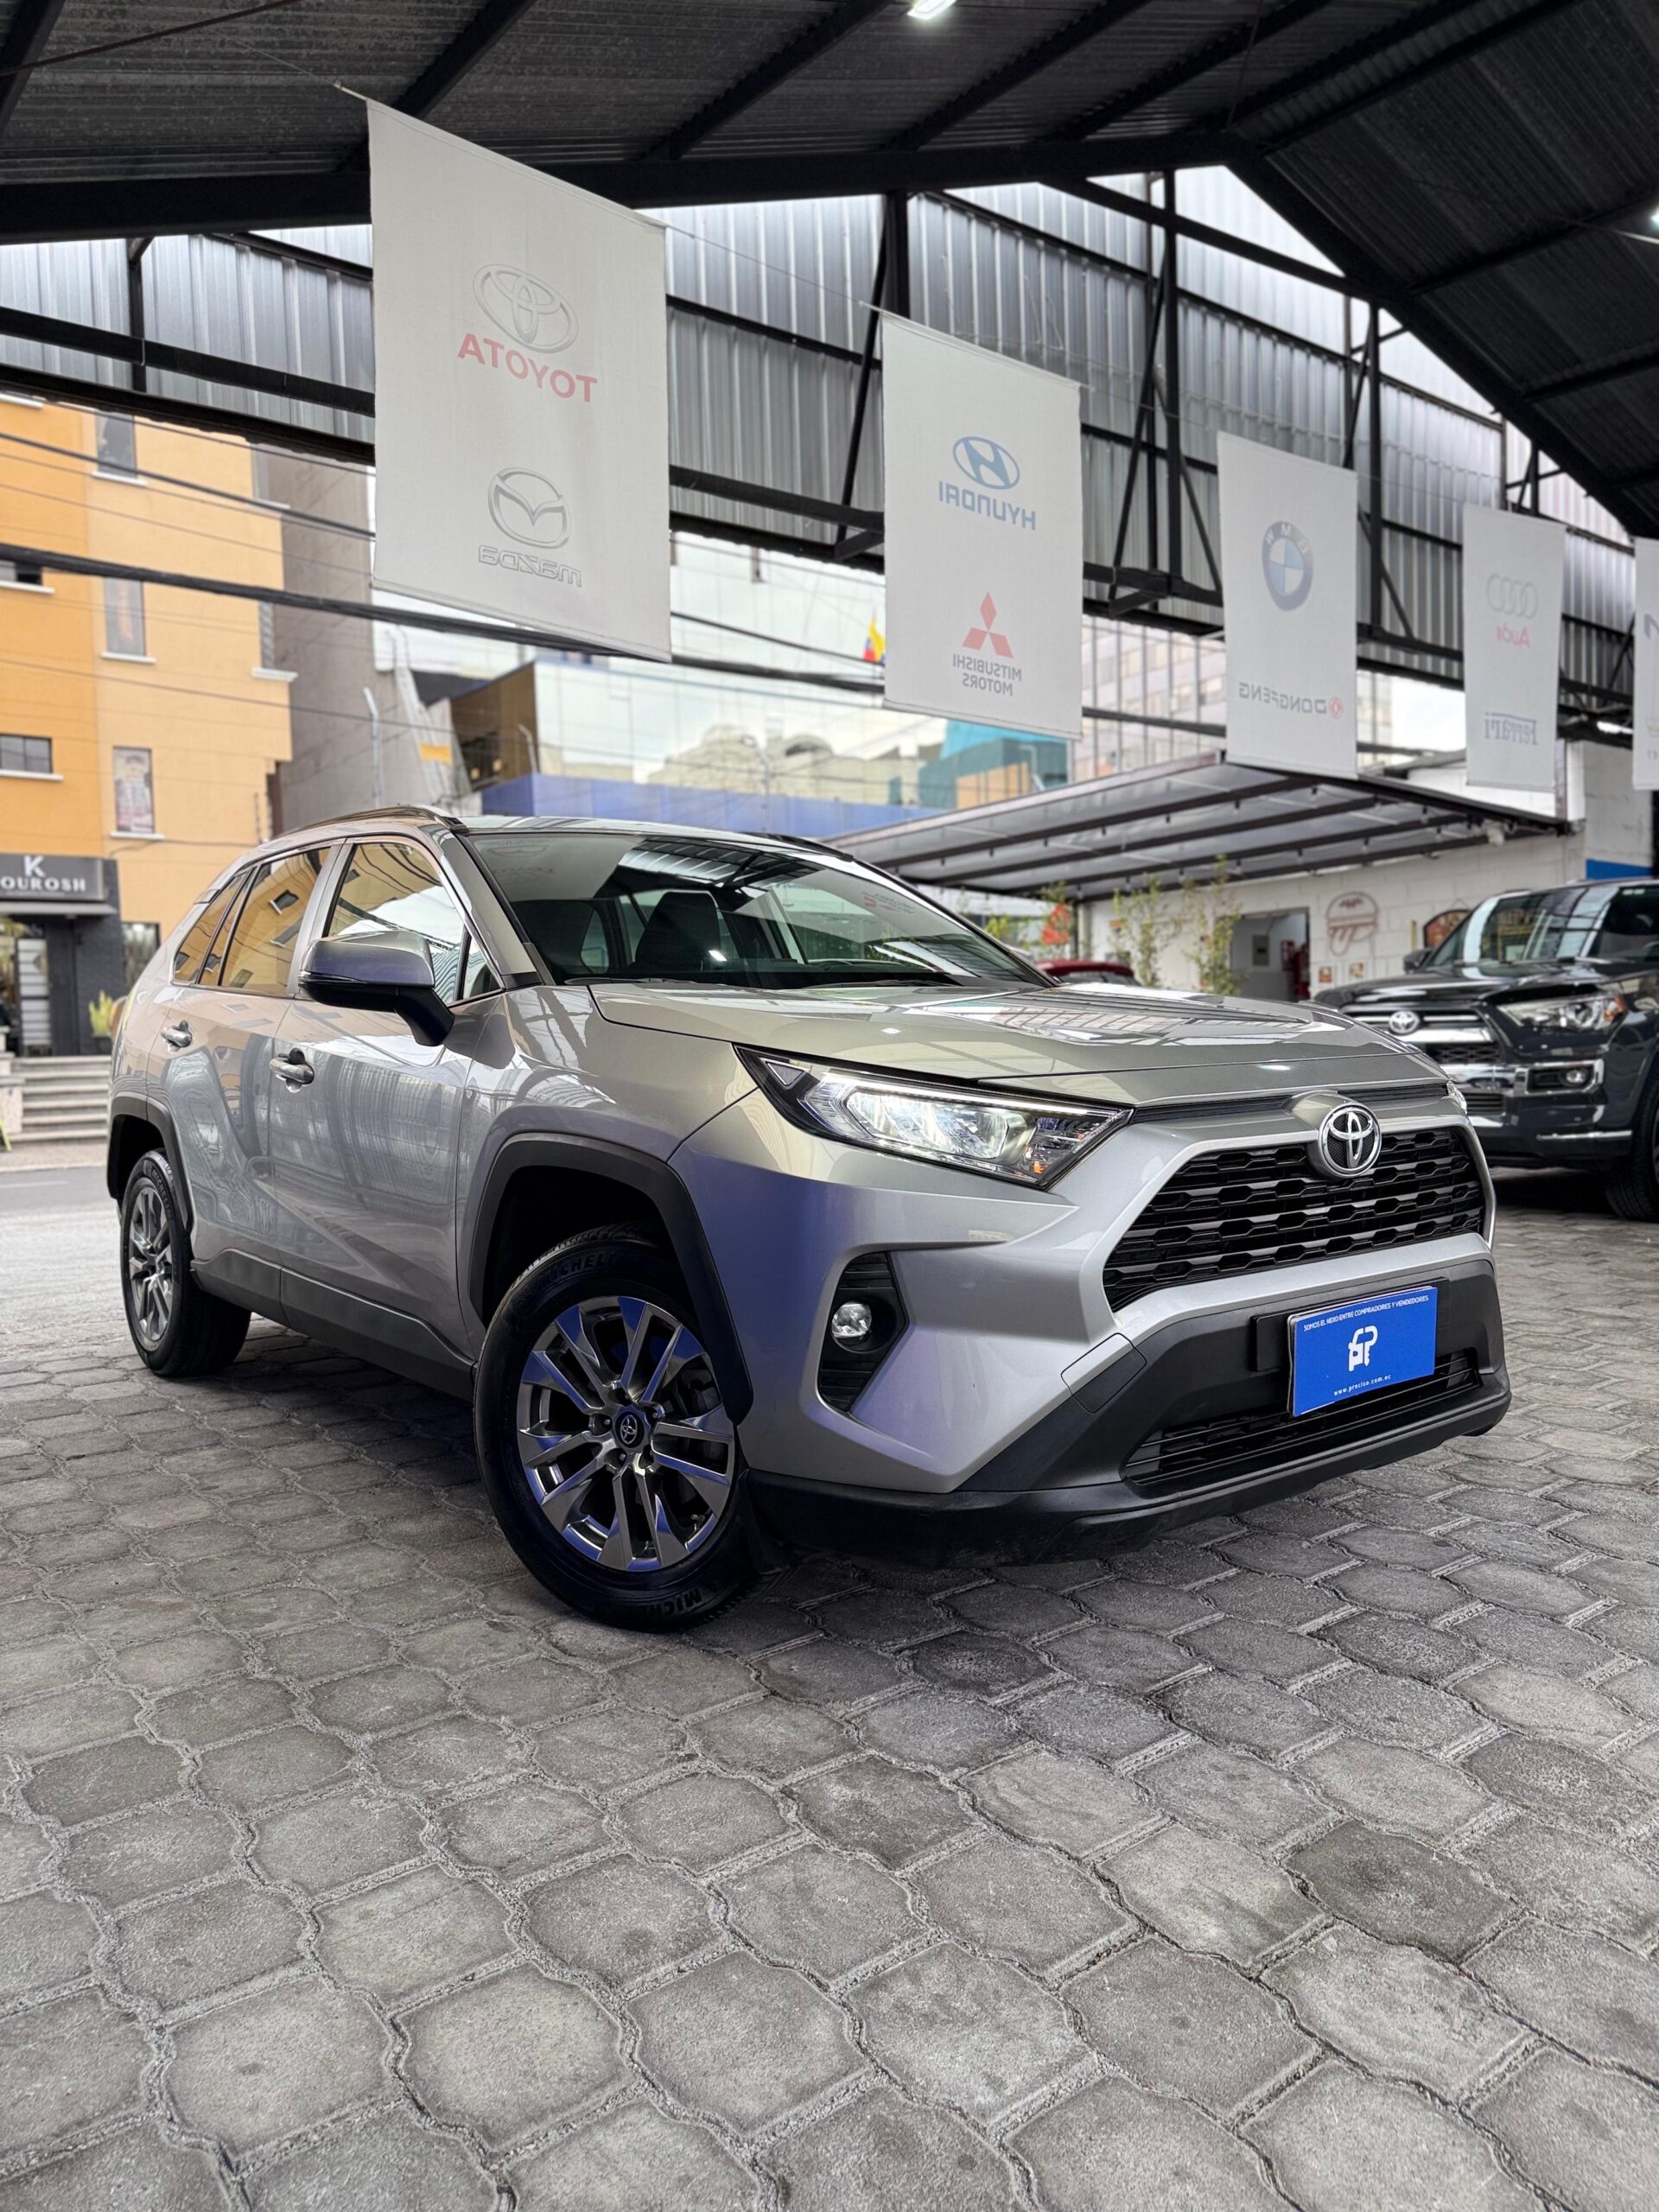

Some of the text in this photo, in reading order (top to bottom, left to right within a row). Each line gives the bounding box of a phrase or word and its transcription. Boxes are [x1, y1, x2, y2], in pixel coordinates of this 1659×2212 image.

[23, 855, 46, 878] K
[1304, 1321, 1320, 1332] SOMOS
[1326, 1315, 1339, 1325] NEXO
[1339, 1311, 1354, 1321] ENTRE
[1354, 1302, 1391, 1317] COMPRADORES
[1395, 1294, 1429, 1307] VENDEDORES
